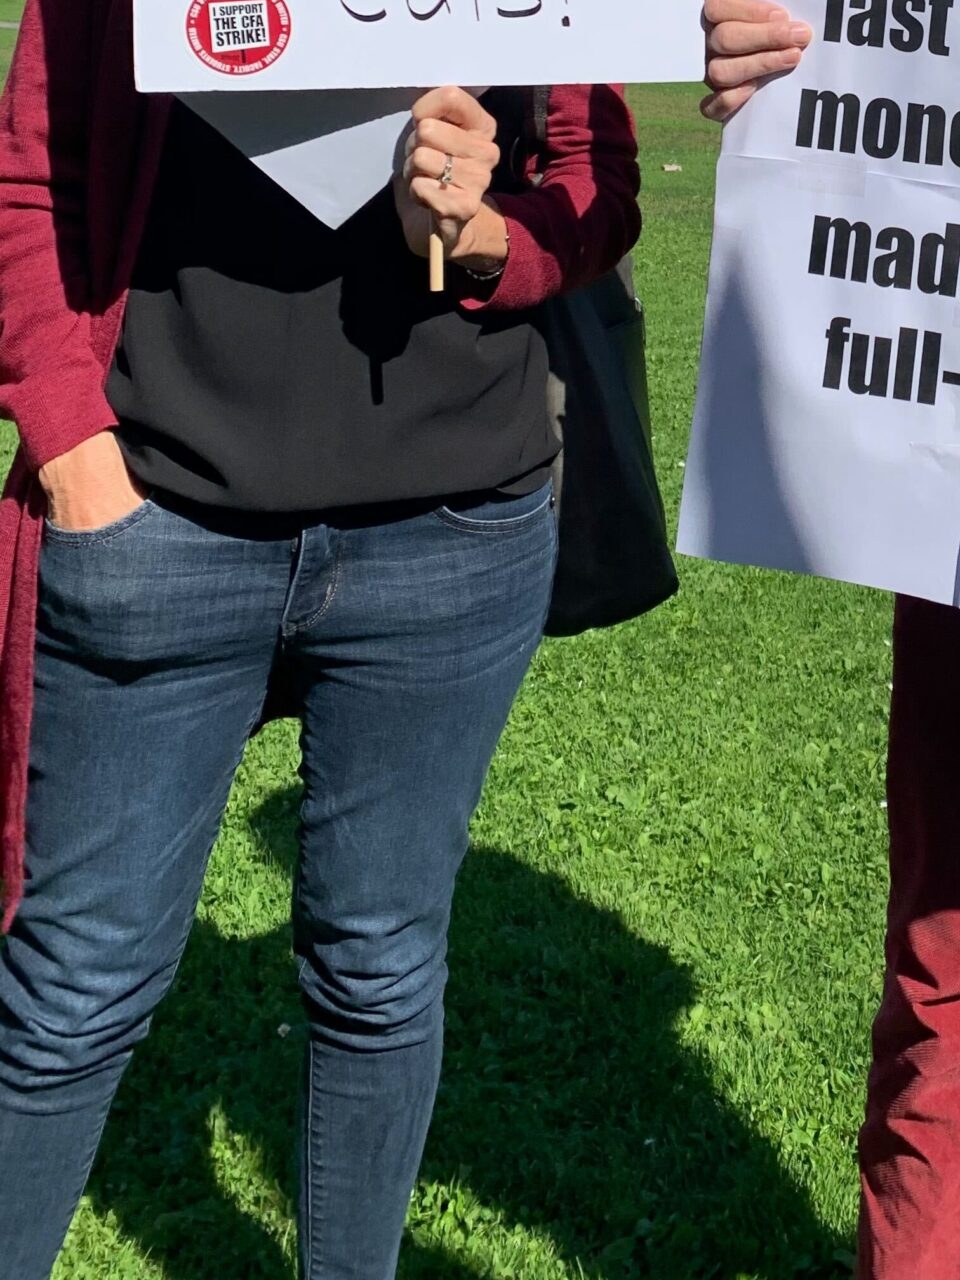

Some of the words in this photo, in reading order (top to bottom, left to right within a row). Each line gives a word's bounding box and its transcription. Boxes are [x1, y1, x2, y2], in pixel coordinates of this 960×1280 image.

[219, 3, 263, 17] SUPPORT
[213, 17, 237, 31] THE
[241, 15, 264, 28] CFA
[216, 28, 266, 47] STRIKE!
